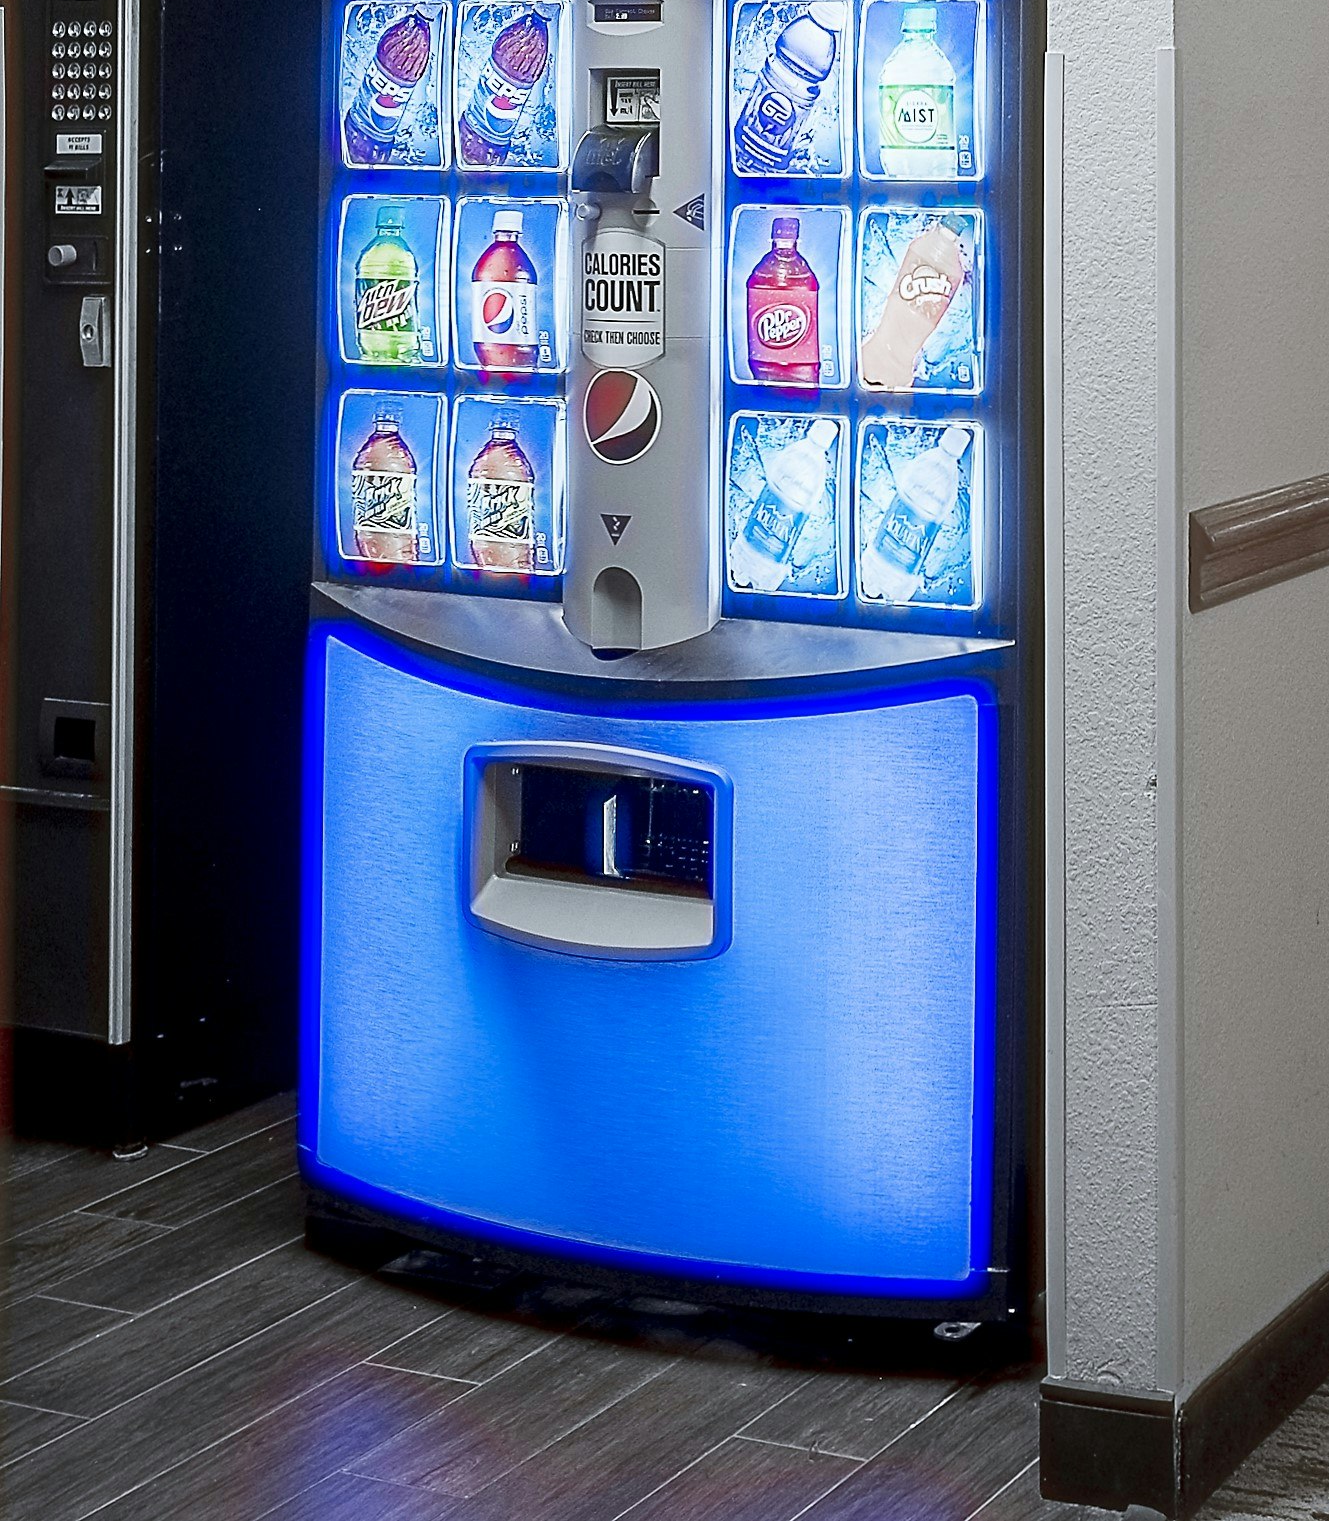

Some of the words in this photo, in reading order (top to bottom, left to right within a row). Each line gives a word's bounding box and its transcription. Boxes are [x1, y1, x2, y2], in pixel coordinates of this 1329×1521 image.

[898, 108, 935, 123] MIST
[585, 252, 661, 277] CALORIES
[763, 312, 802, 342] Pepper
[773, 309, 793, 327] Dr
[584, 330, 603, 344] CHECK
[605, 331, 625, 345] THEN
[626, 331, 661, 345] CHOOSE
